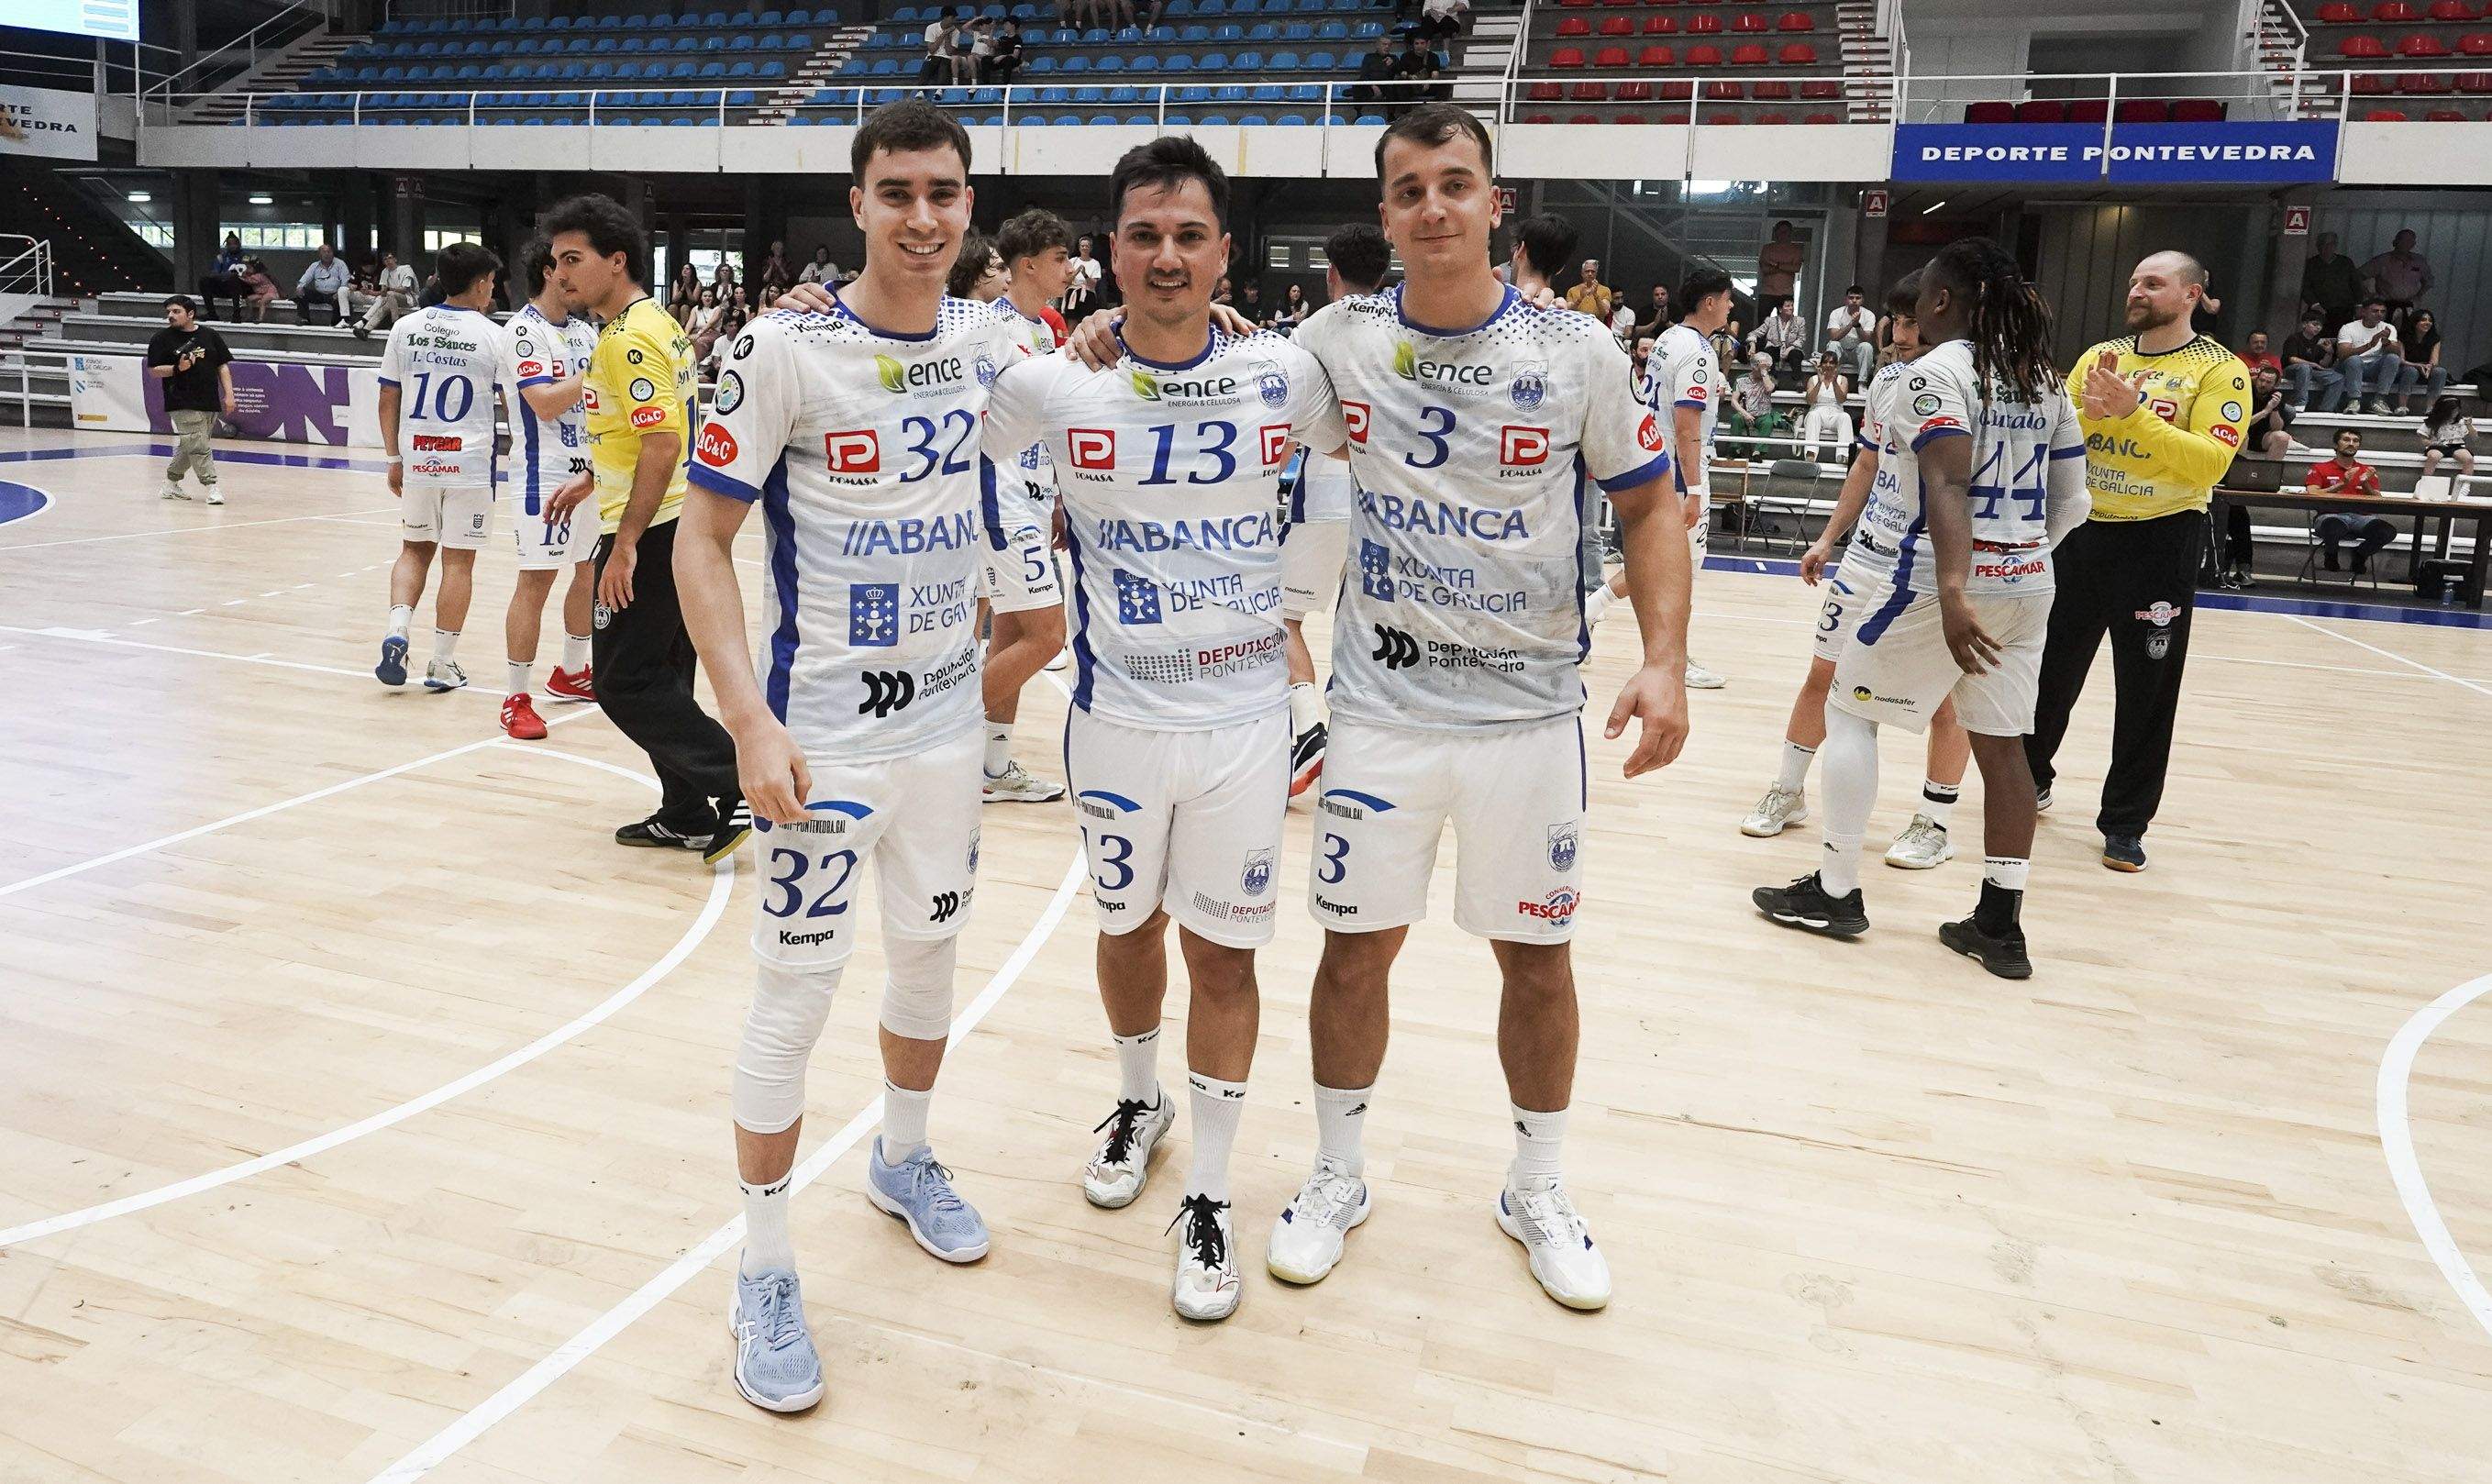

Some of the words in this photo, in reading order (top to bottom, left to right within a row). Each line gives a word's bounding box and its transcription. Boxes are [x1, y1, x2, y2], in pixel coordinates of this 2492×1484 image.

[0, 117, 77, 133] VEDRA
[1922, 147, 2068, 161] DEPORTE
[2083, 145, 2316, 161] PONTEVEDRA
[1501, 194, 1512, 205] A
[1869, 196, 1883, 209] A
[2289, 213, 2304, 226] A
[425, 324, 460, 337] Colegio
[407, 334, 429, 347] Los
[434, 337, 477, 352] Sauces
[426, 352, 468, 367] Costas
[908, 357, 962, 386] ence
[1419, 360, 1492, 385] ence
[409, 371, 473, 423] 10
[1163, 377, 1236, 397] ence
[1206, 397, 1241, 406] CELULOSA
[633, 410, 662, 426] AC&C
[697, 431, 731, 460] AC&C
[900, 409, 974, 482] 32
[1405, 405, 1456, 469] 3
[2212, 426, 2238, 446] AC&C
[1137, 420, 1237, 485] 13
[413, 465, 460, 473] PESCAMAR
[1967, 441, 2048, 521] 44
[2099, 481, 2154, 496] GALICIA
[539, 519, 570, 545] 18
[1024, 546, 1046, 581] 5
[1397, 556, 1475, 589] XUNTA
[1976, 561, 2045, 578] PESCAMAR
[1170, 592, 1203, 612] DE
[1398, 580, 1427, 602] DE
[1432, 587, 1527, 613] GALICIA
[910, 611, 936, 633] DE
[1875, 695, 1915, 706] nodosafer
[1318, 833, 1350, 884] 3
[763, 847, 858, 918] 32
[1316, 893, 1357, 916] Kempa
[780, 929, 834, 946] Kempa
